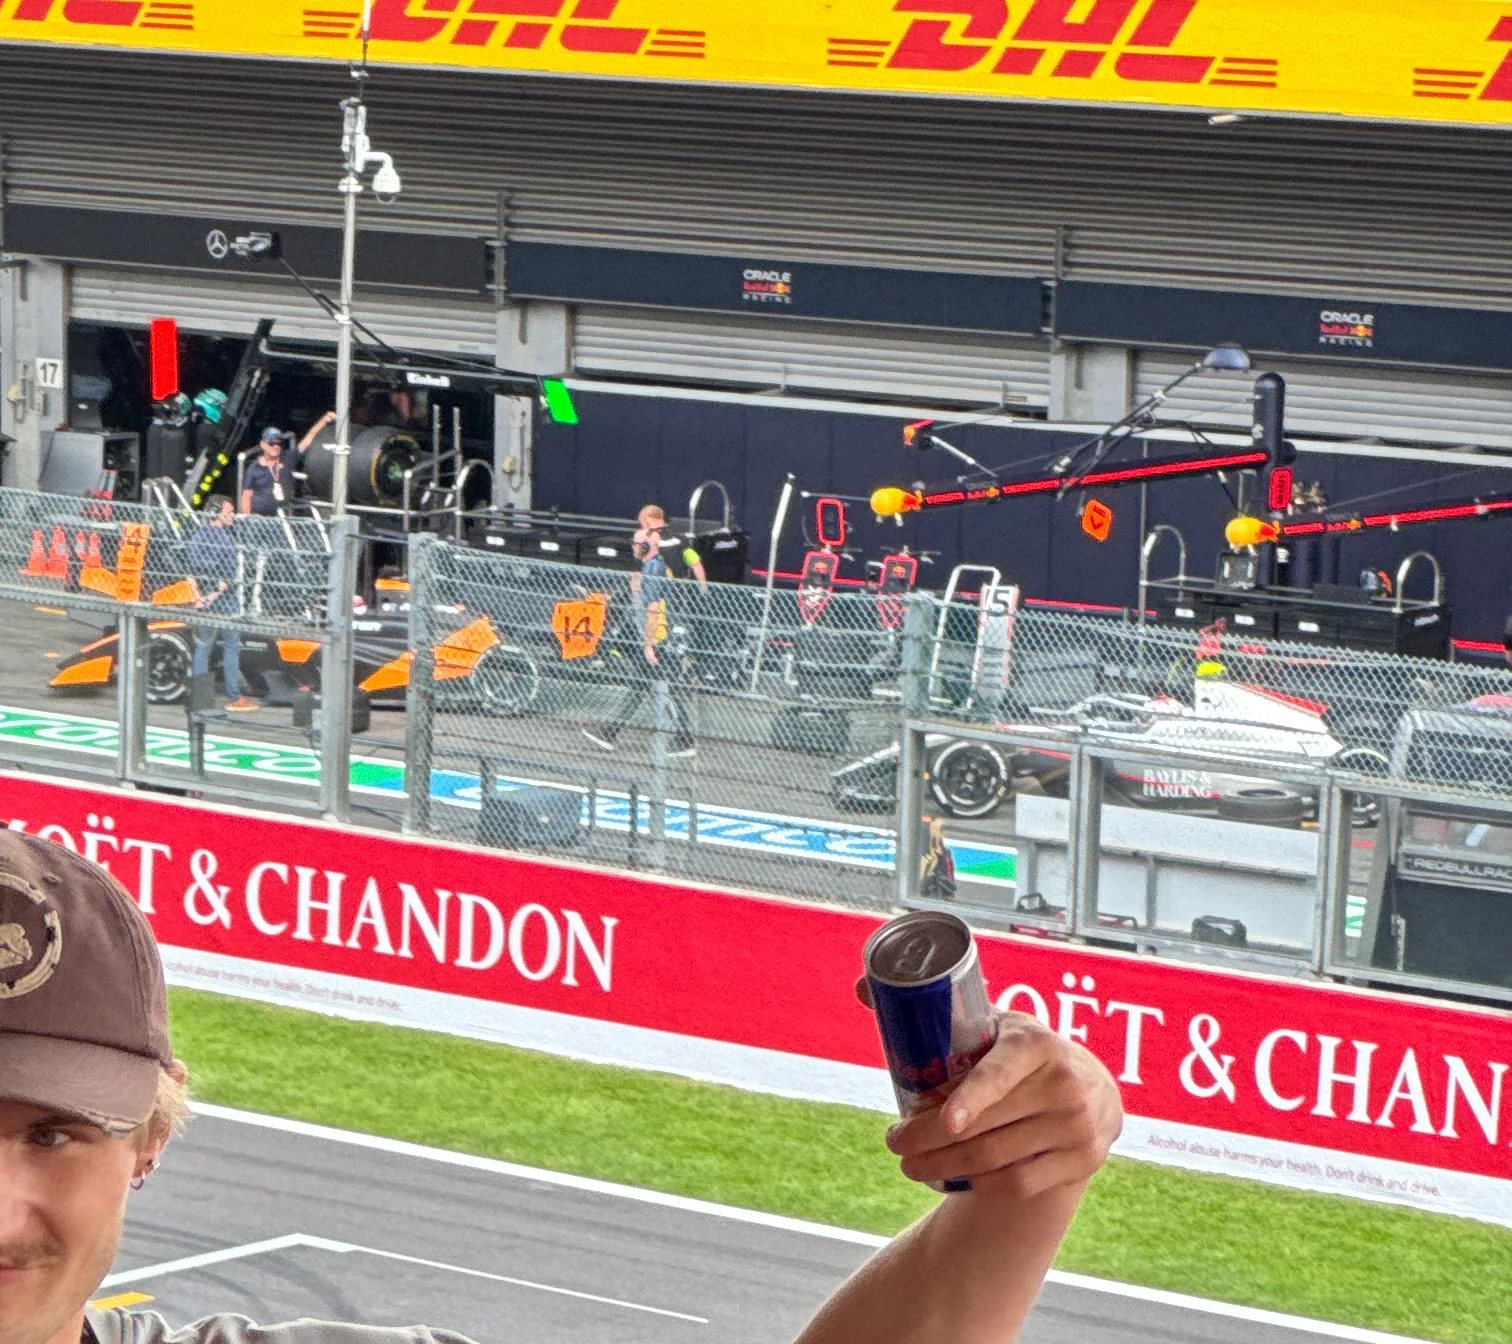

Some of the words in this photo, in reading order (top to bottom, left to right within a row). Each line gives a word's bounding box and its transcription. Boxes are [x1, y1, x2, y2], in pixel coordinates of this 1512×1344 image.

[884, 0, 1215, 84] DHL
[40, 362, 59, 385] 17
[563, 615, 591, 645] 14
[1142, 783, 1212, 799] HARDING
[1143, 769, 1199, 785] BAYLIS
[184, 848, 232, 930] &
[244, 859, 619, 993] CHANDON
[993, 972, 1166, 1086] OËT
[1178, 1012, 1237, 1104] &
[1148, 1134, 1187, 1151] Alcohol
[1189, 1142, 1221, 1158] abuse
[1223, 1147, 1258, 1165] harms
